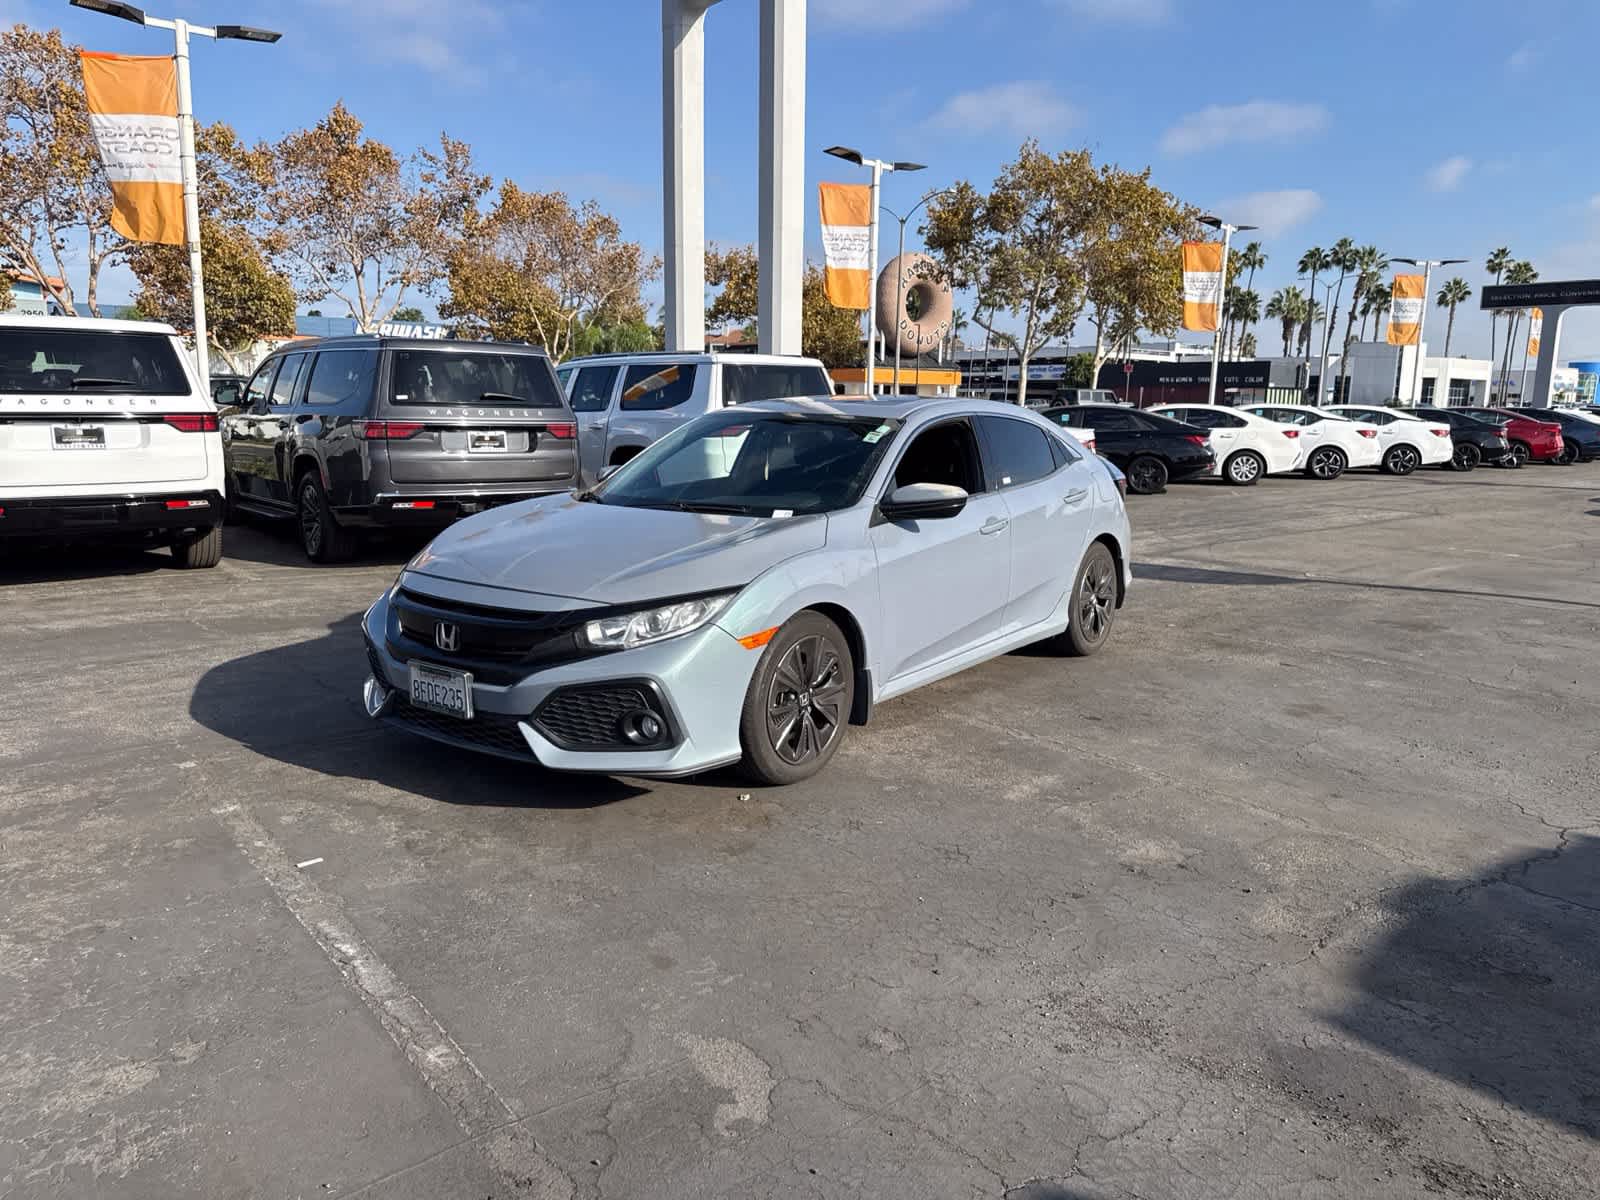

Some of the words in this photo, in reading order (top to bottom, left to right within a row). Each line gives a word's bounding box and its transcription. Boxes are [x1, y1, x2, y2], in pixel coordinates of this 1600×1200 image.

[900, 320, 947, 344] DONUTS
[0, 398, 157, 406] AGONEER
[413, 680, 464, 711] 8FDE235
